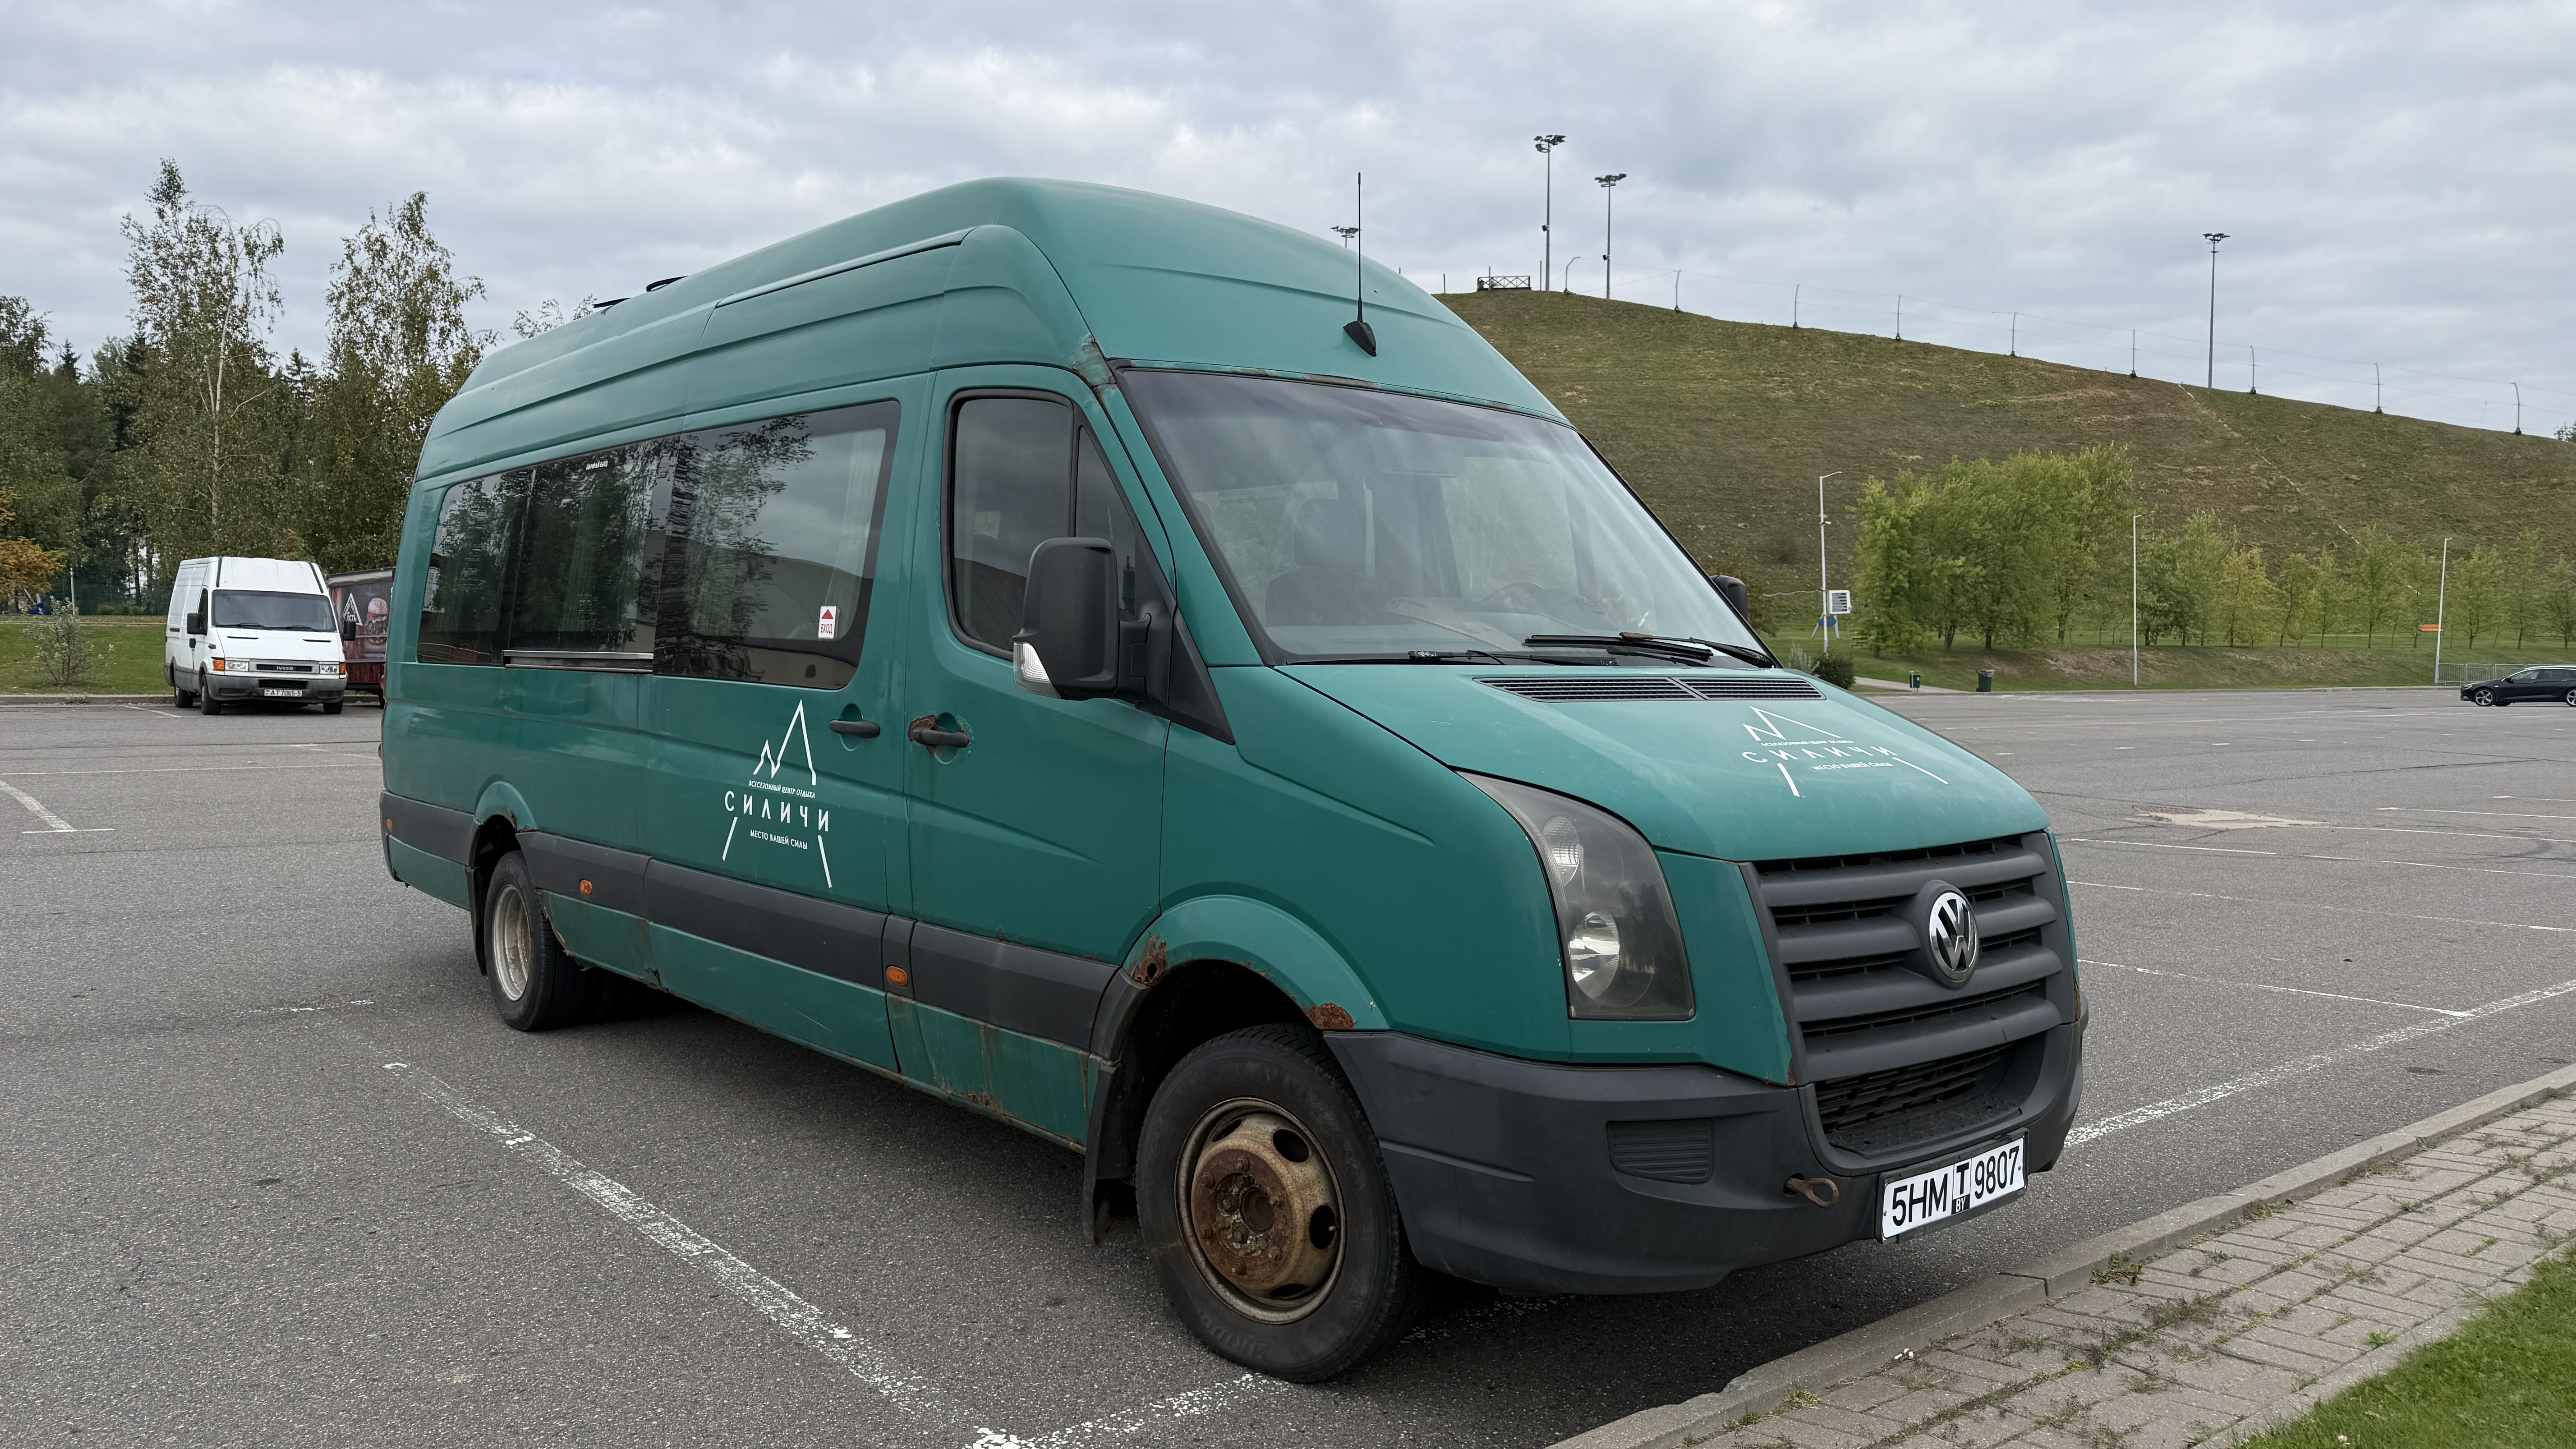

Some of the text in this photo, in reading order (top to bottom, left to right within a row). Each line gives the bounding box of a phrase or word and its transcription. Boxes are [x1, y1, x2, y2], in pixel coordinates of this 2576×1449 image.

[821, 624, 833, 635] ВХОД
[1741, 745, 1898, 763] СИЛИЧИ
[749, 780, 815, 799] ВСЕСЕЗОННЫЙ ЦЕНТР ОТДЫХА
[724, 791, 829, 832] СИЛИЧИ
[750, 829, 808, 850] МЕСТО ВАШЕЙ СИЛЫ
[1892, 1173, 1948, 1226] 5HM
[1974, 1145, 2020, 1200] 9807
[1955, 1196, 1966, 1213] BY
